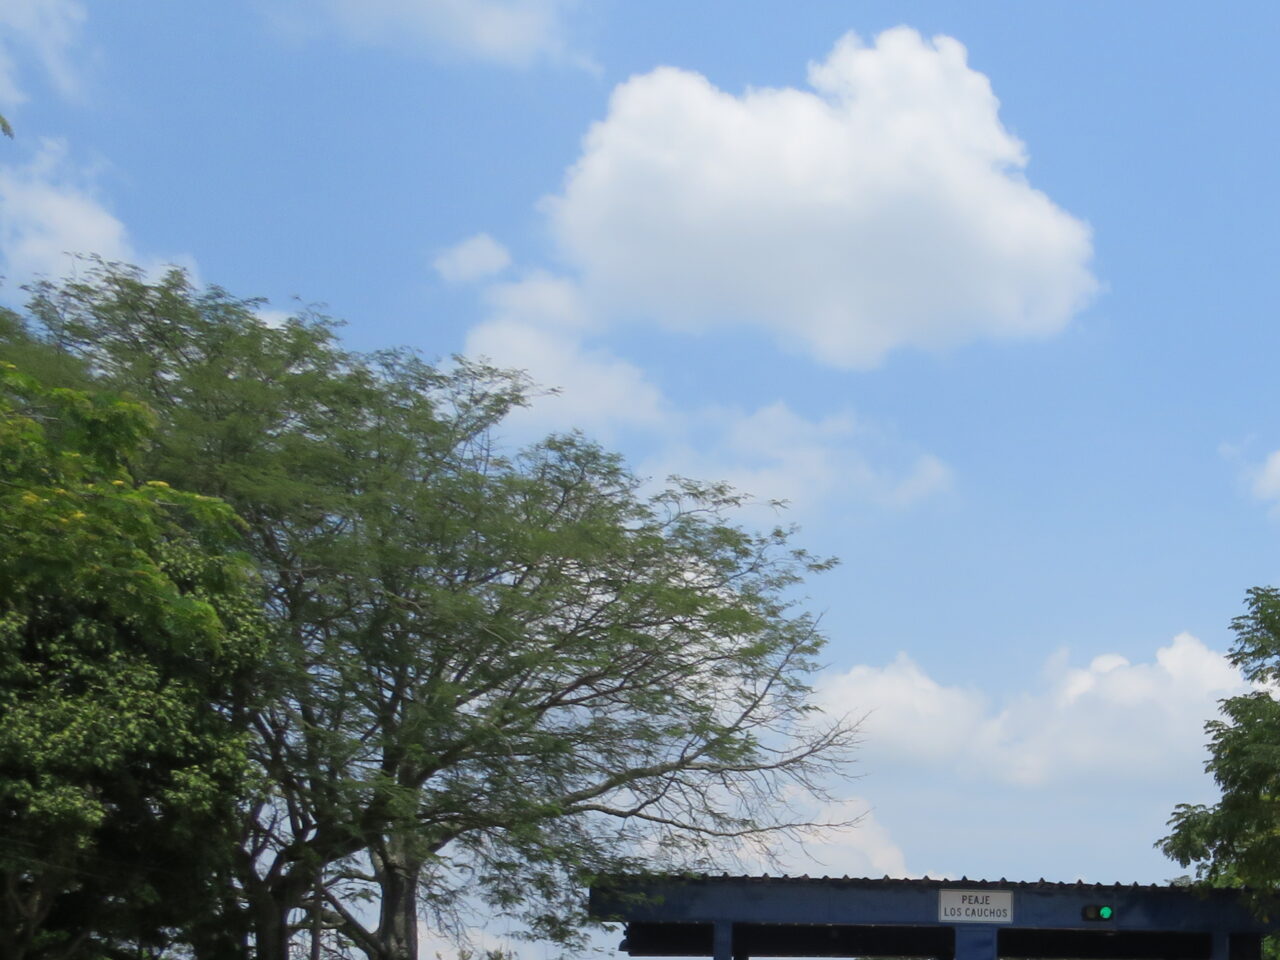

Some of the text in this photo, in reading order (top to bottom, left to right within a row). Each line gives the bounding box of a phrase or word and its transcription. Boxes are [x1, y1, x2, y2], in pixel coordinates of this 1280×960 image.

[961, 895, 990, 905] PEAJE
[944, 907, 1008, 918] LOS CAUCHOS
